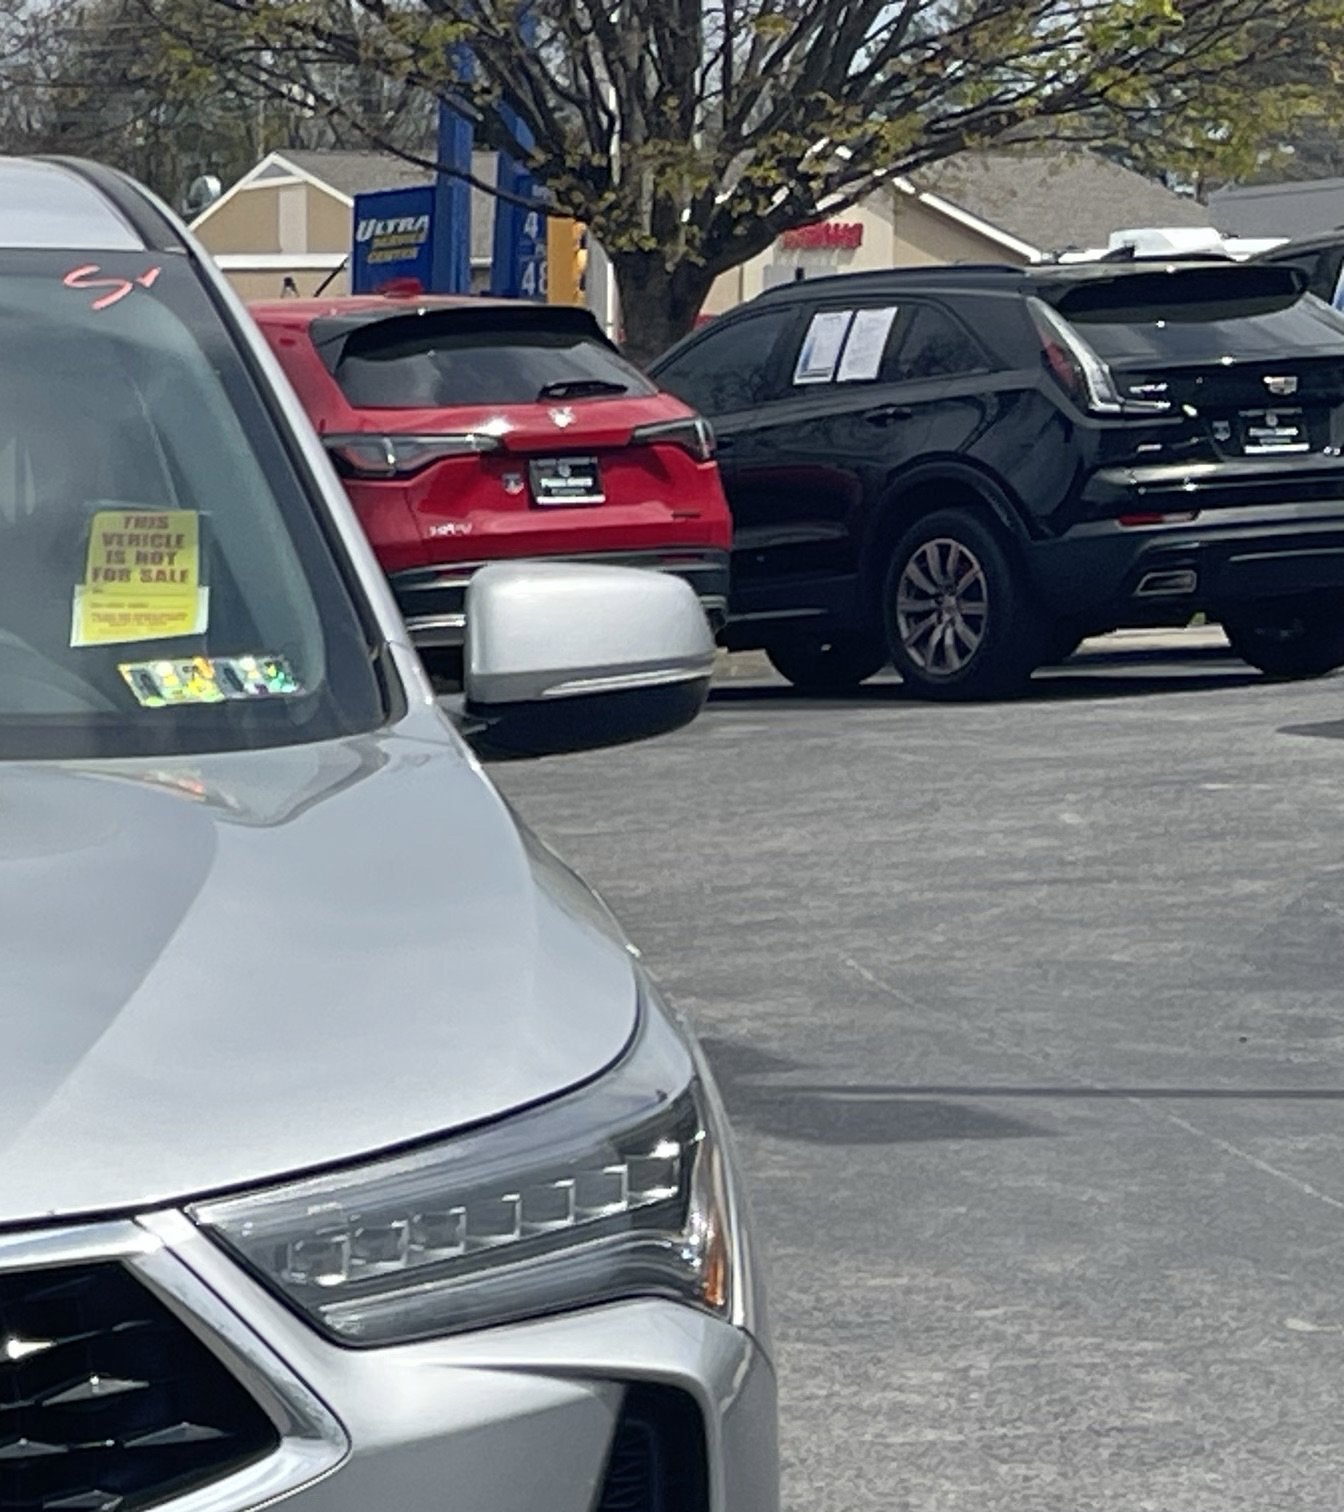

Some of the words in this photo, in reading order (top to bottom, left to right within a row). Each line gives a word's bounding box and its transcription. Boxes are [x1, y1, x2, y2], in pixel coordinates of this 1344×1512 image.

[355, 215, 431, 242] ULTRA
[124, 515, 169, 529] THIS
[102, 533, 185, 549] VEHICLE
[106, 551, 126, 565] IS
[135, 552, 178, 565] NOT
[92, 568, 131, 583] FOR
[140, 568, 189, 583] SALE
